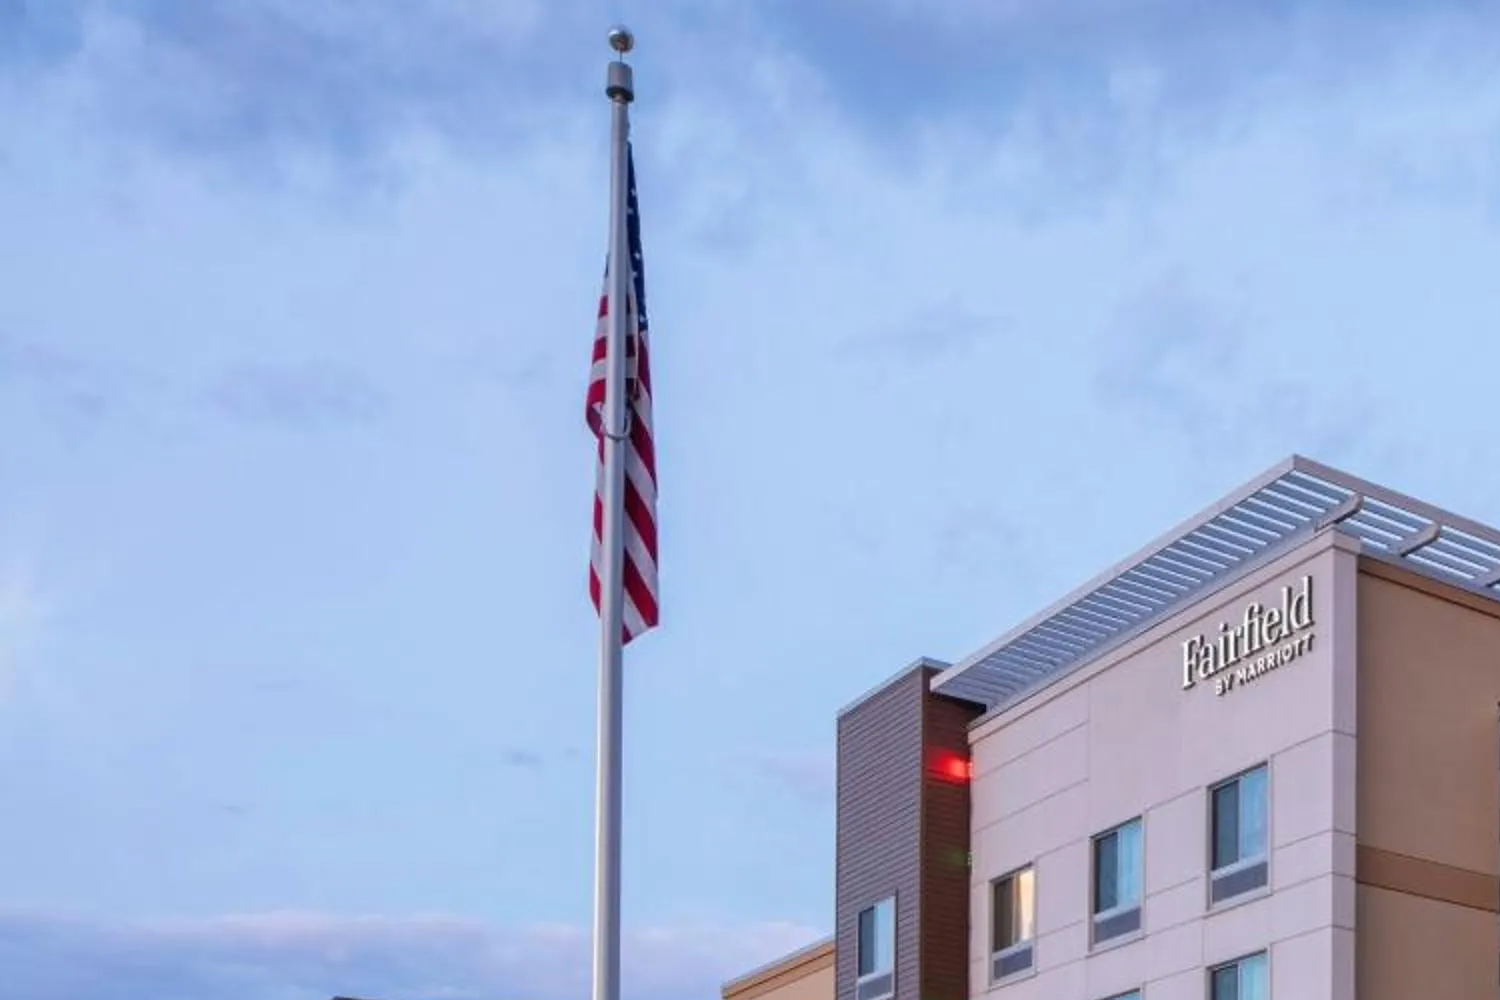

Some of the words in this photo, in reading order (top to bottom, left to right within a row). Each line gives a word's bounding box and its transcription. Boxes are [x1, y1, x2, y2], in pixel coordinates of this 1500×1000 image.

[1183, 575, 1315, 690] Fairfield
[1215, 672, 1235, 696] BY
[1236, 633, 1315, 686] MARRIOTT
